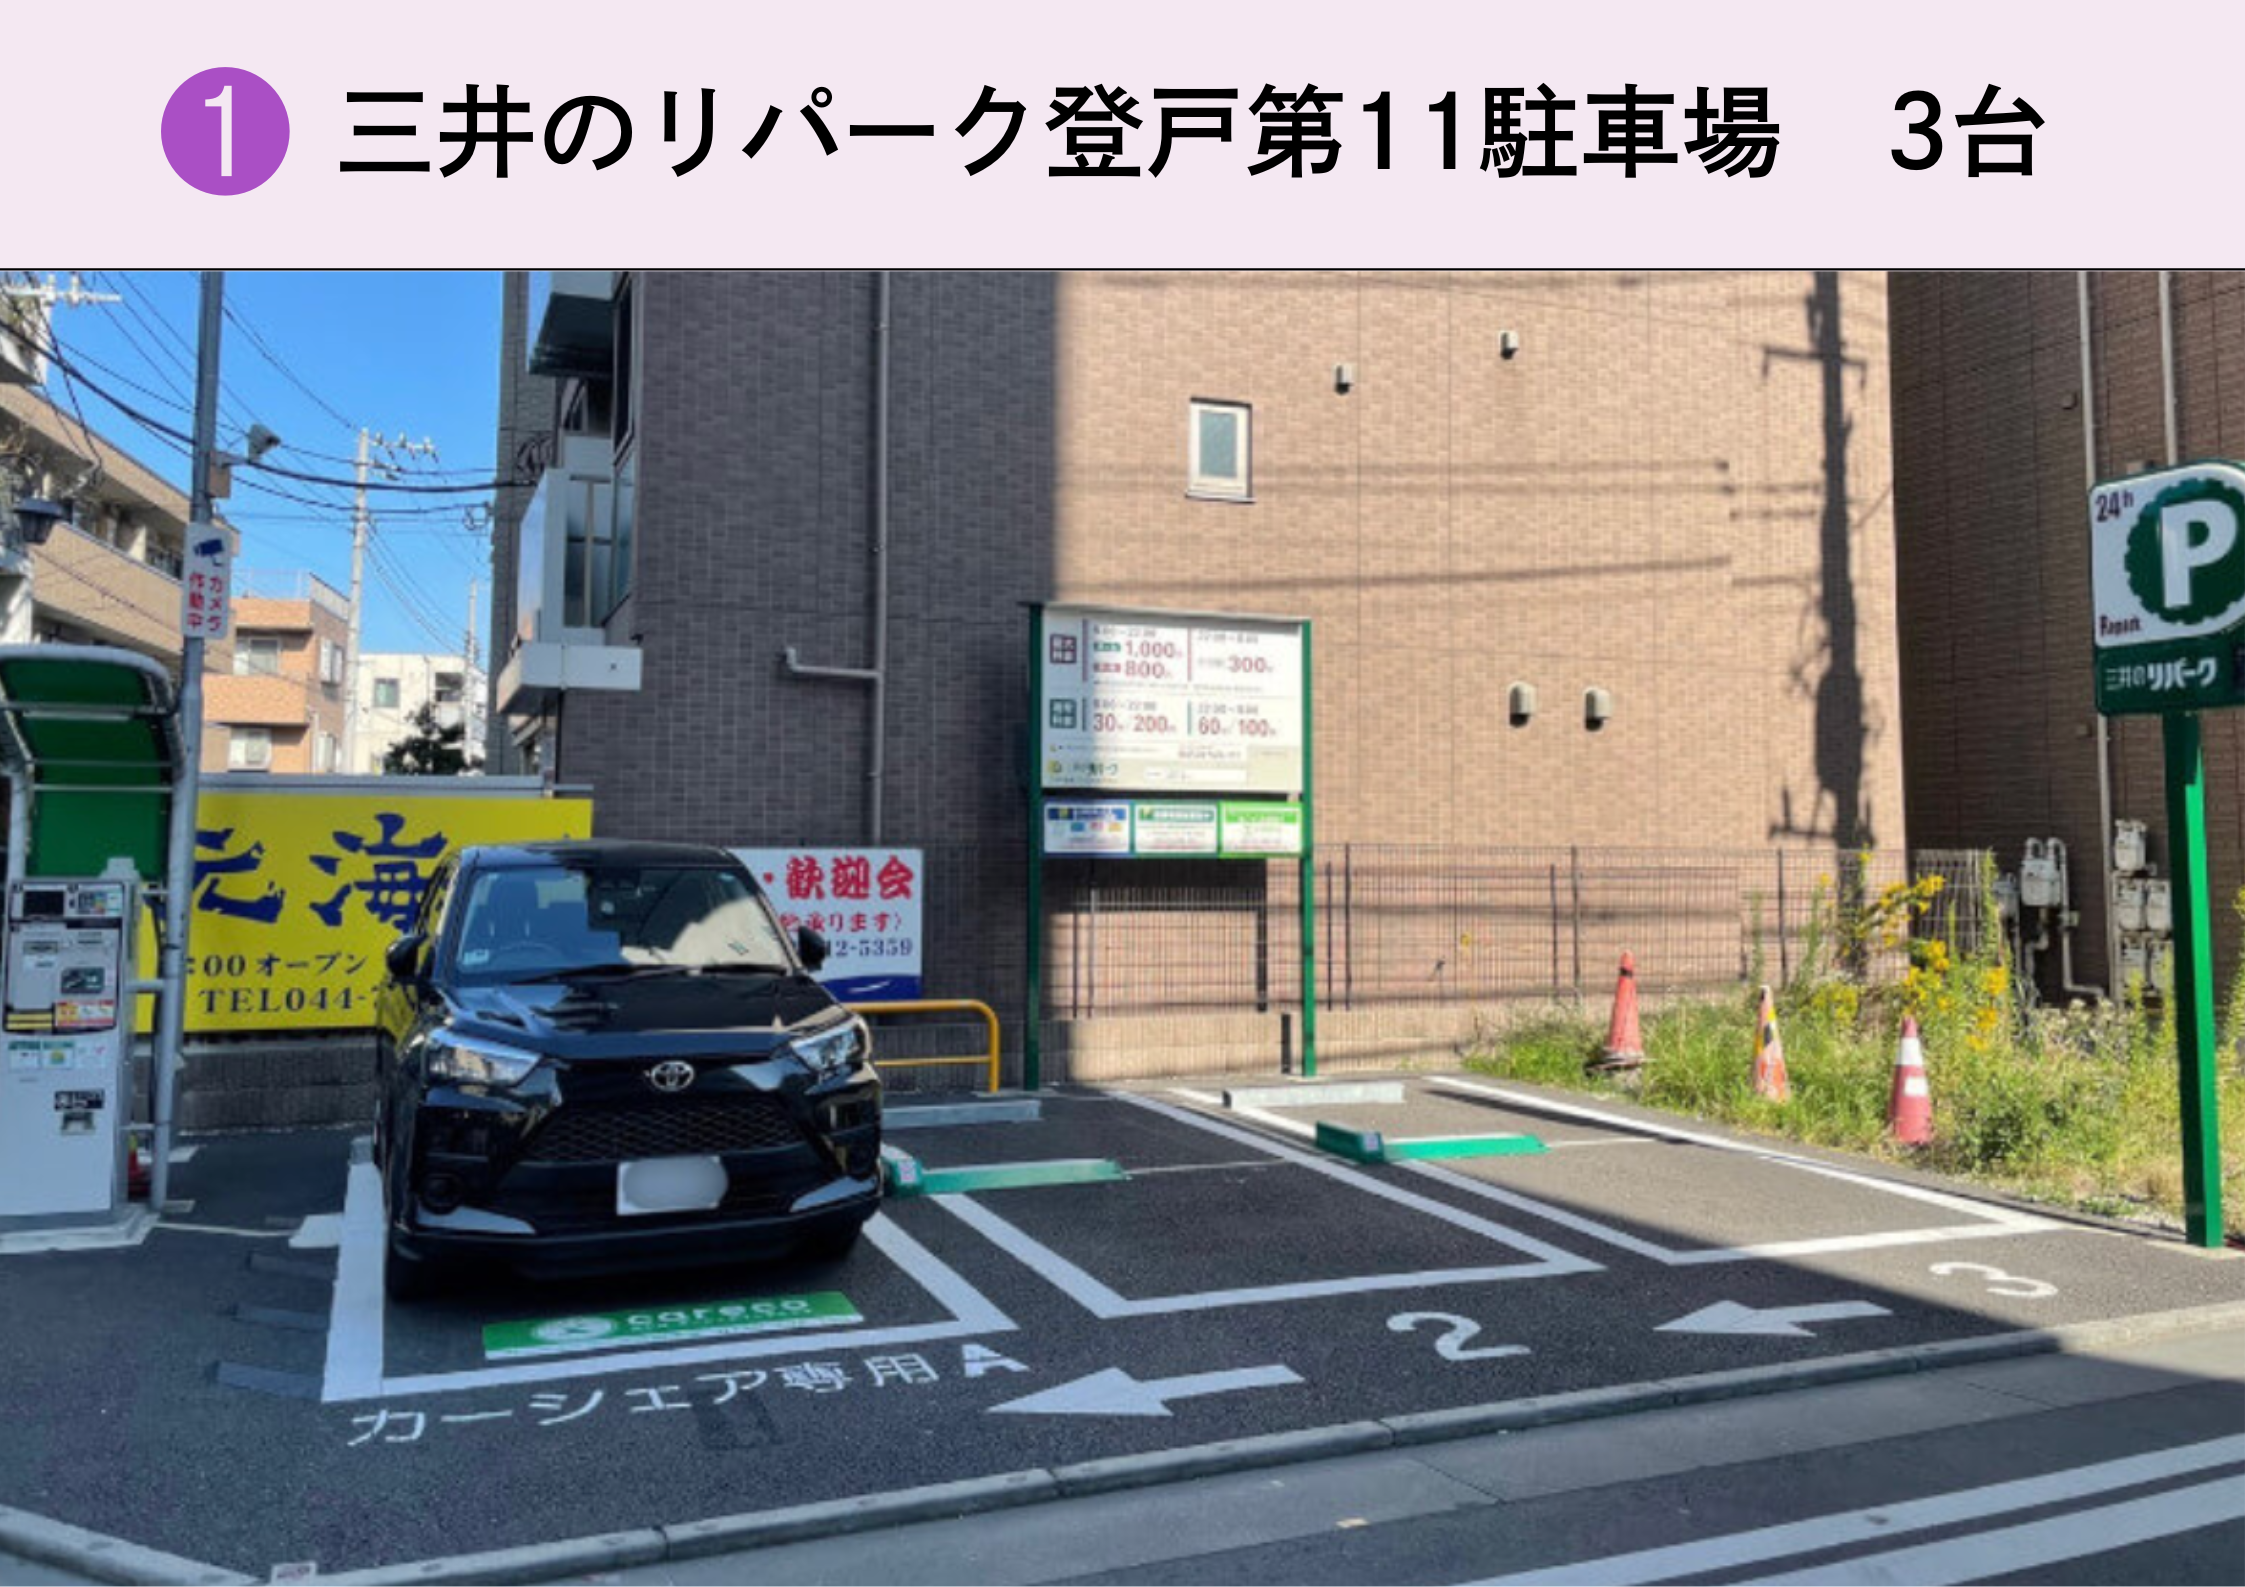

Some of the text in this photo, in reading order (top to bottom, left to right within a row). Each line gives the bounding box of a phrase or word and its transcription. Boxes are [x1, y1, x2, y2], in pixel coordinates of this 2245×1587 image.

[2096, 489, 2134, 523] 24h
[2161, 499, 2239, 609] P
[208, 576, 222, 632] カメラ
[1124, 640, 1182, 659] 1,000
[1228, 655, 1275, 674] 300
[1124, 660, 1173, 679] 800
[2105, 656, 2218, 692] 三井のリパーク
[1929, 1260, 2060, 1299] 3
[1385, 1310, 1532, 1362] 2
